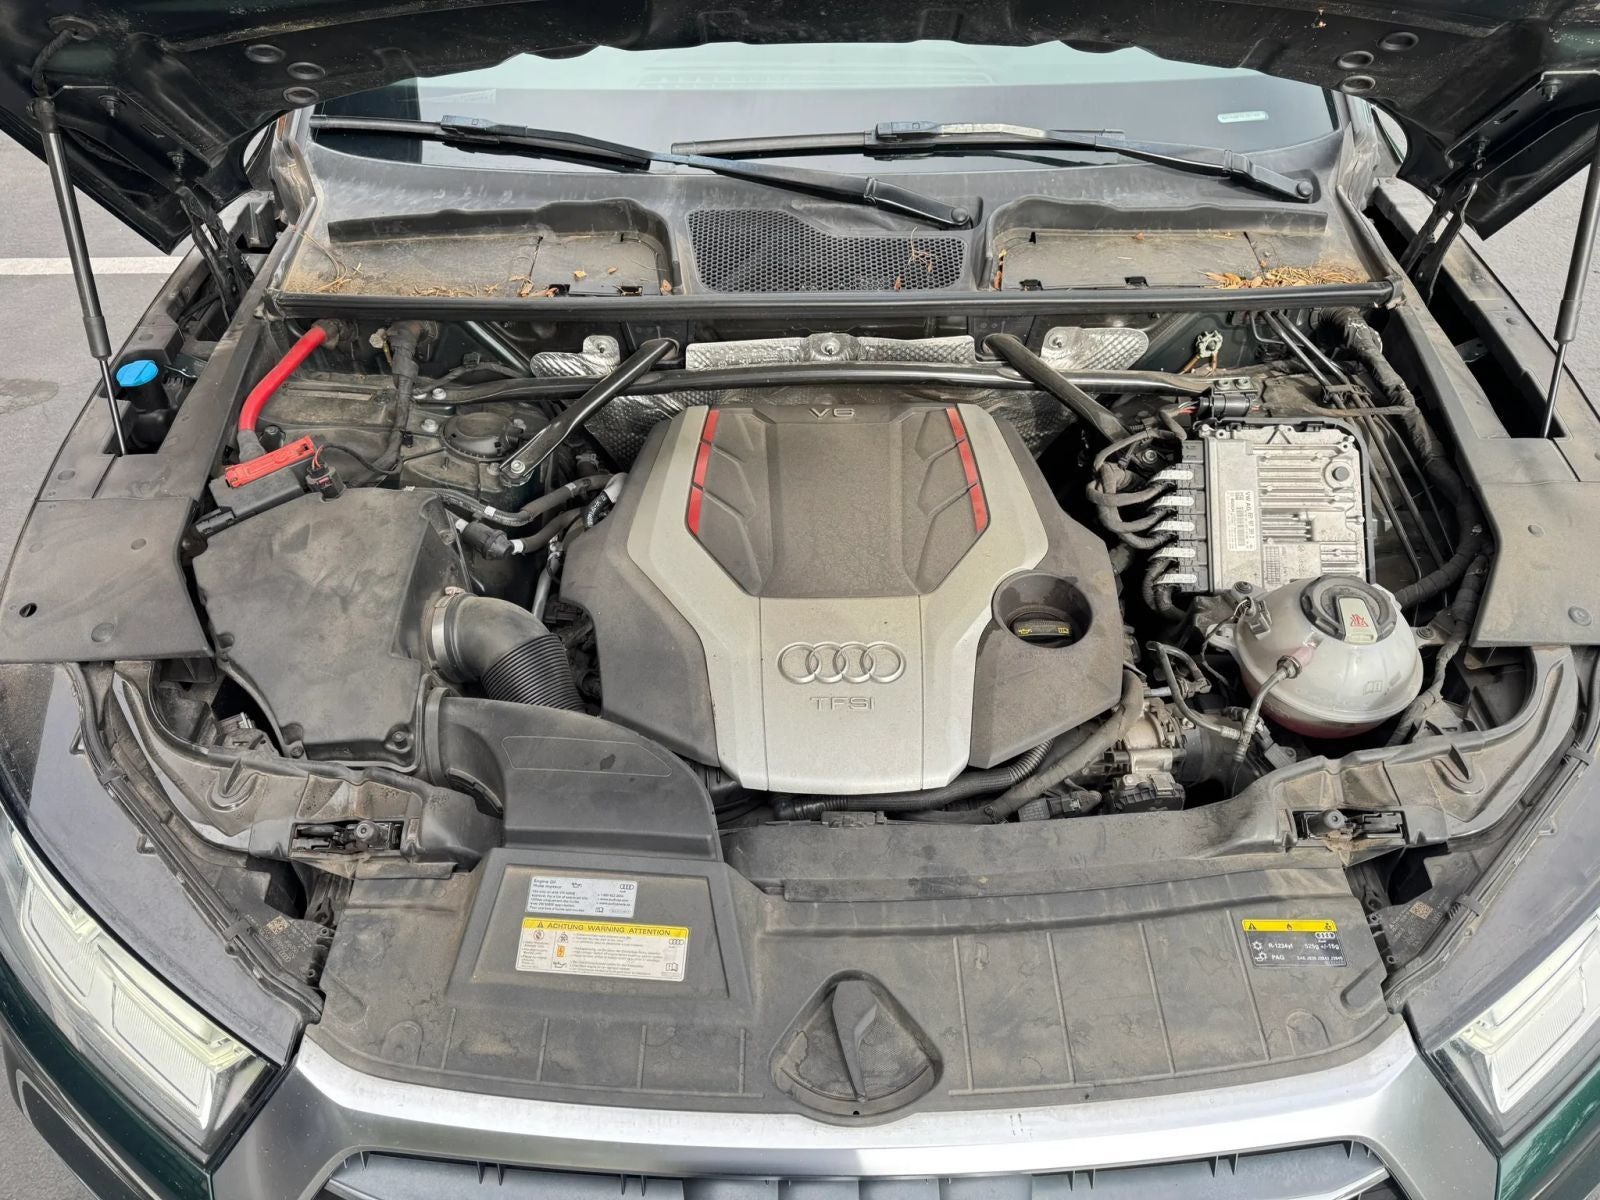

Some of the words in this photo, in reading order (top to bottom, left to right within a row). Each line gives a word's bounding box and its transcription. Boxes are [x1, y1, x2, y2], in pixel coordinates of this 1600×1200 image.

[809, 407, 856, 418] V6
[809, 696, 875, 711] TFSI
[547, 922, 584, 931] ACHTUNG
[587, 925, 625, 933] WARNING
[628, 927, 671, 936] ATTENTION
